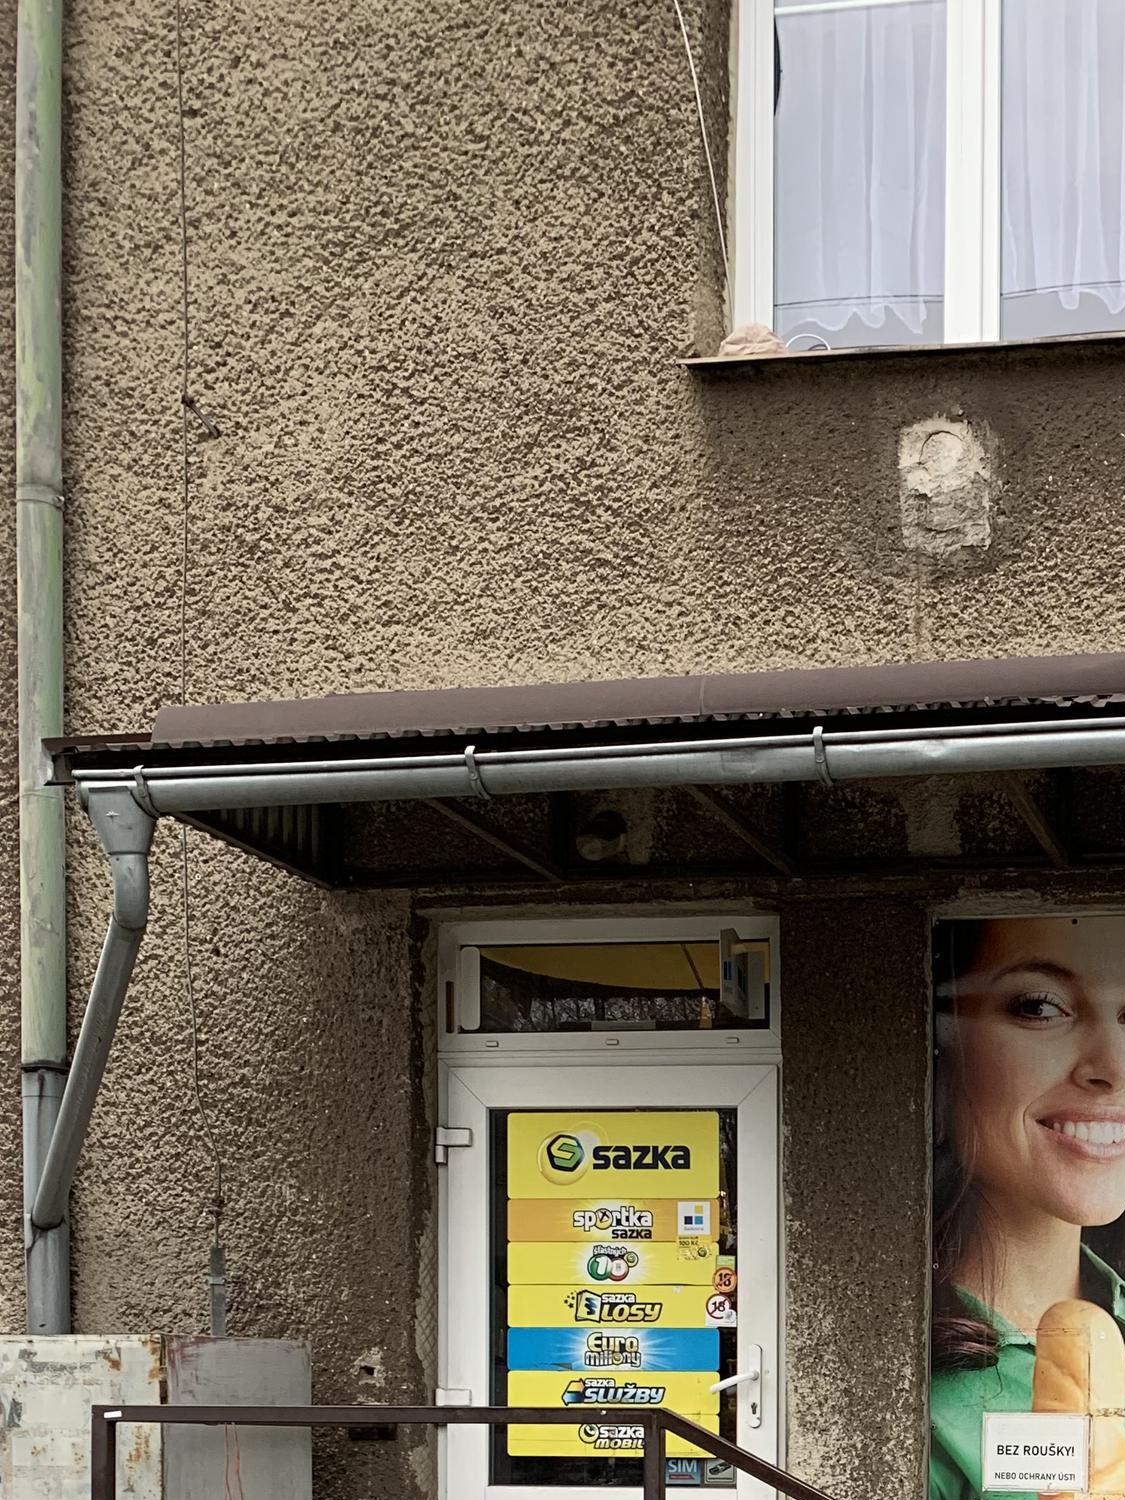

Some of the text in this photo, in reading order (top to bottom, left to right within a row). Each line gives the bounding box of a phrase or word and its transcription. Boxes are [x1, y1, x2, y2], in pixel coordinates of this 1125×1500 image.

[573, 1206, 653, 1232] sportka
[587, 1332, 639, 1353] Euro
[997, 1443, 1075, 1457] BEZ ROUŠKY!
[668, 1459, 698, 1473] SIM
[995, 1472, 1017, 1480] NEBO
[1018, 1472, 1057, 1481] OCHRANY
